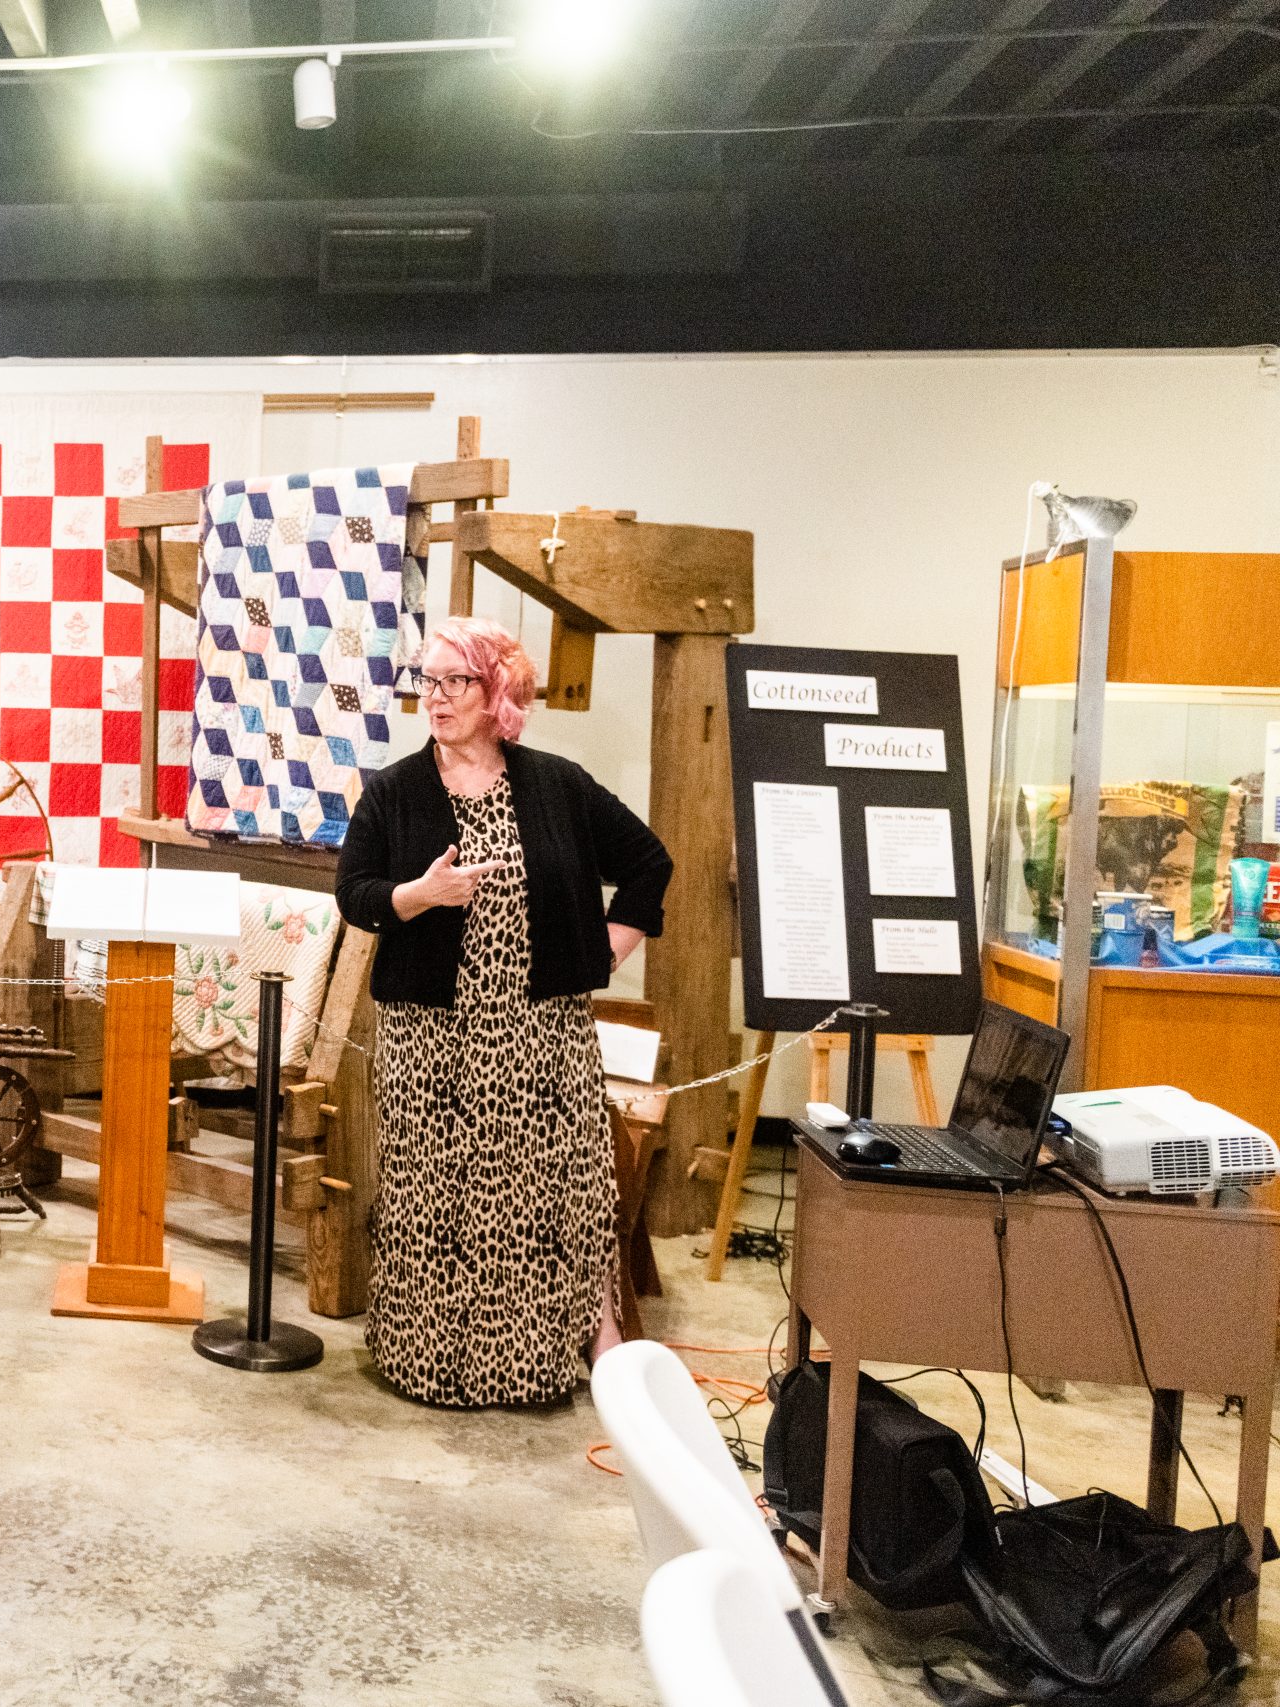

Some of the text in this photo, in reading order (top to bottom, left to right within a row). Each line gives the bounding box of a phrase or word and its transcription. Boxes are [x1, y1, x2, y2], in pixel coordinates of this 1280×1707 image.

[753, 681, 873, 705] Cottonseed
[837, 737, 933, 760] Products
[761, 787, 780, 796] From
[783, 788, 794, 796] the
[872, 813, 893, 822] From
[895, 813, 906, 822] the
[880, 926, 902, 934] From
[903, 926, 915, 934] the
